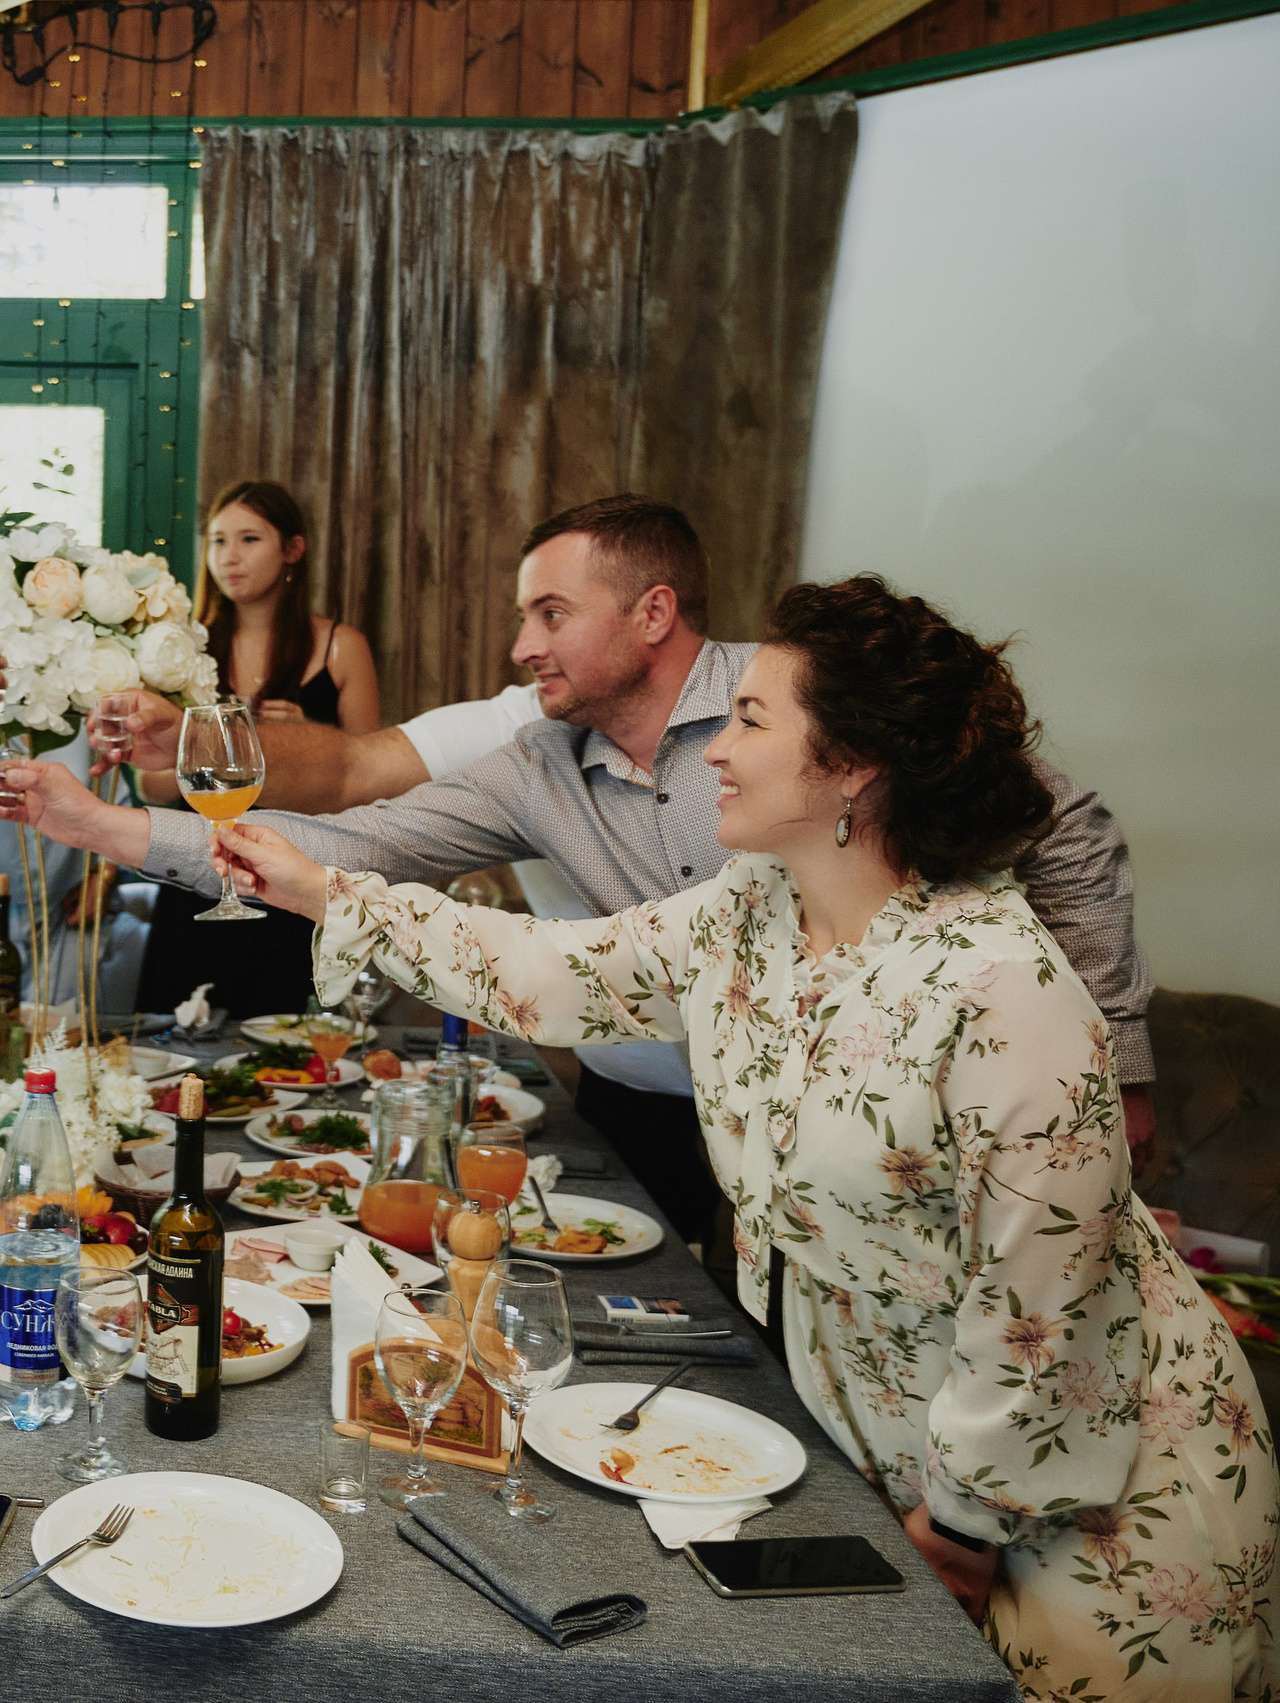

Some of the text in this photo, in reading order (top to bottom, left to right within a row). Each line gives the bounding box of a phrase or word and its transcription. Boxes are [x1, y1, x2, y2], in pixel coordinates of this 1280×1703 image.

[165, 1265, 193, 1278] ДОЛИНА
[149, 1303, 177, 1318] ABLA
[1, 1311, 58, 1332] СУНЖ
